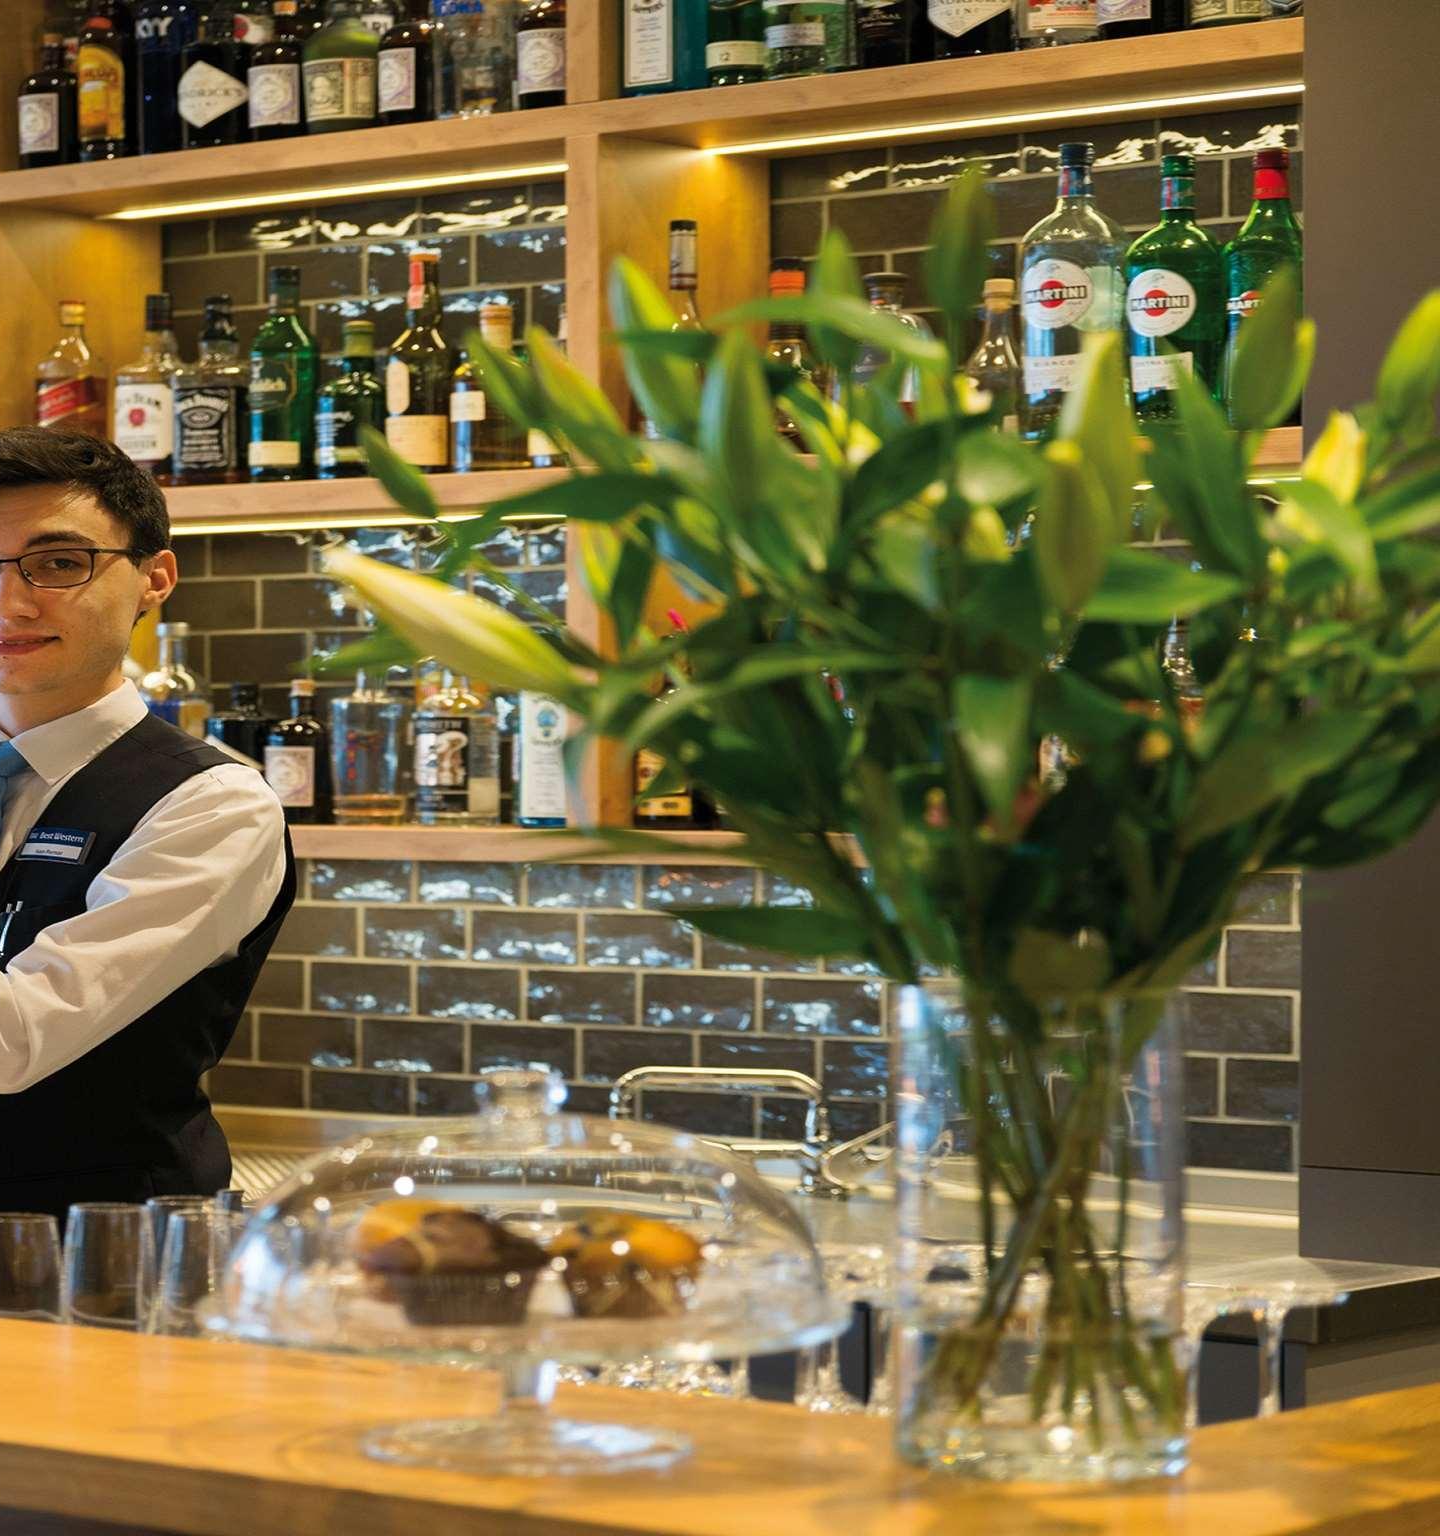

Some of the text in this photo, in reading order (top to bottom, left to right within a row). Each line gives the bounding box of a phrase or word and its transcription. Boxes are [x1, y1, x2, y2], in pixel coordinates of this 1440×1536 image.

[1025, 286, 1087, 304] MARTINI
[1131, 295, 1190, 312] MARTINI
[1226, 299, 1261, 312] MART
[40, 832, 54, 840] Best
[54, 832, 85, 843] Western
